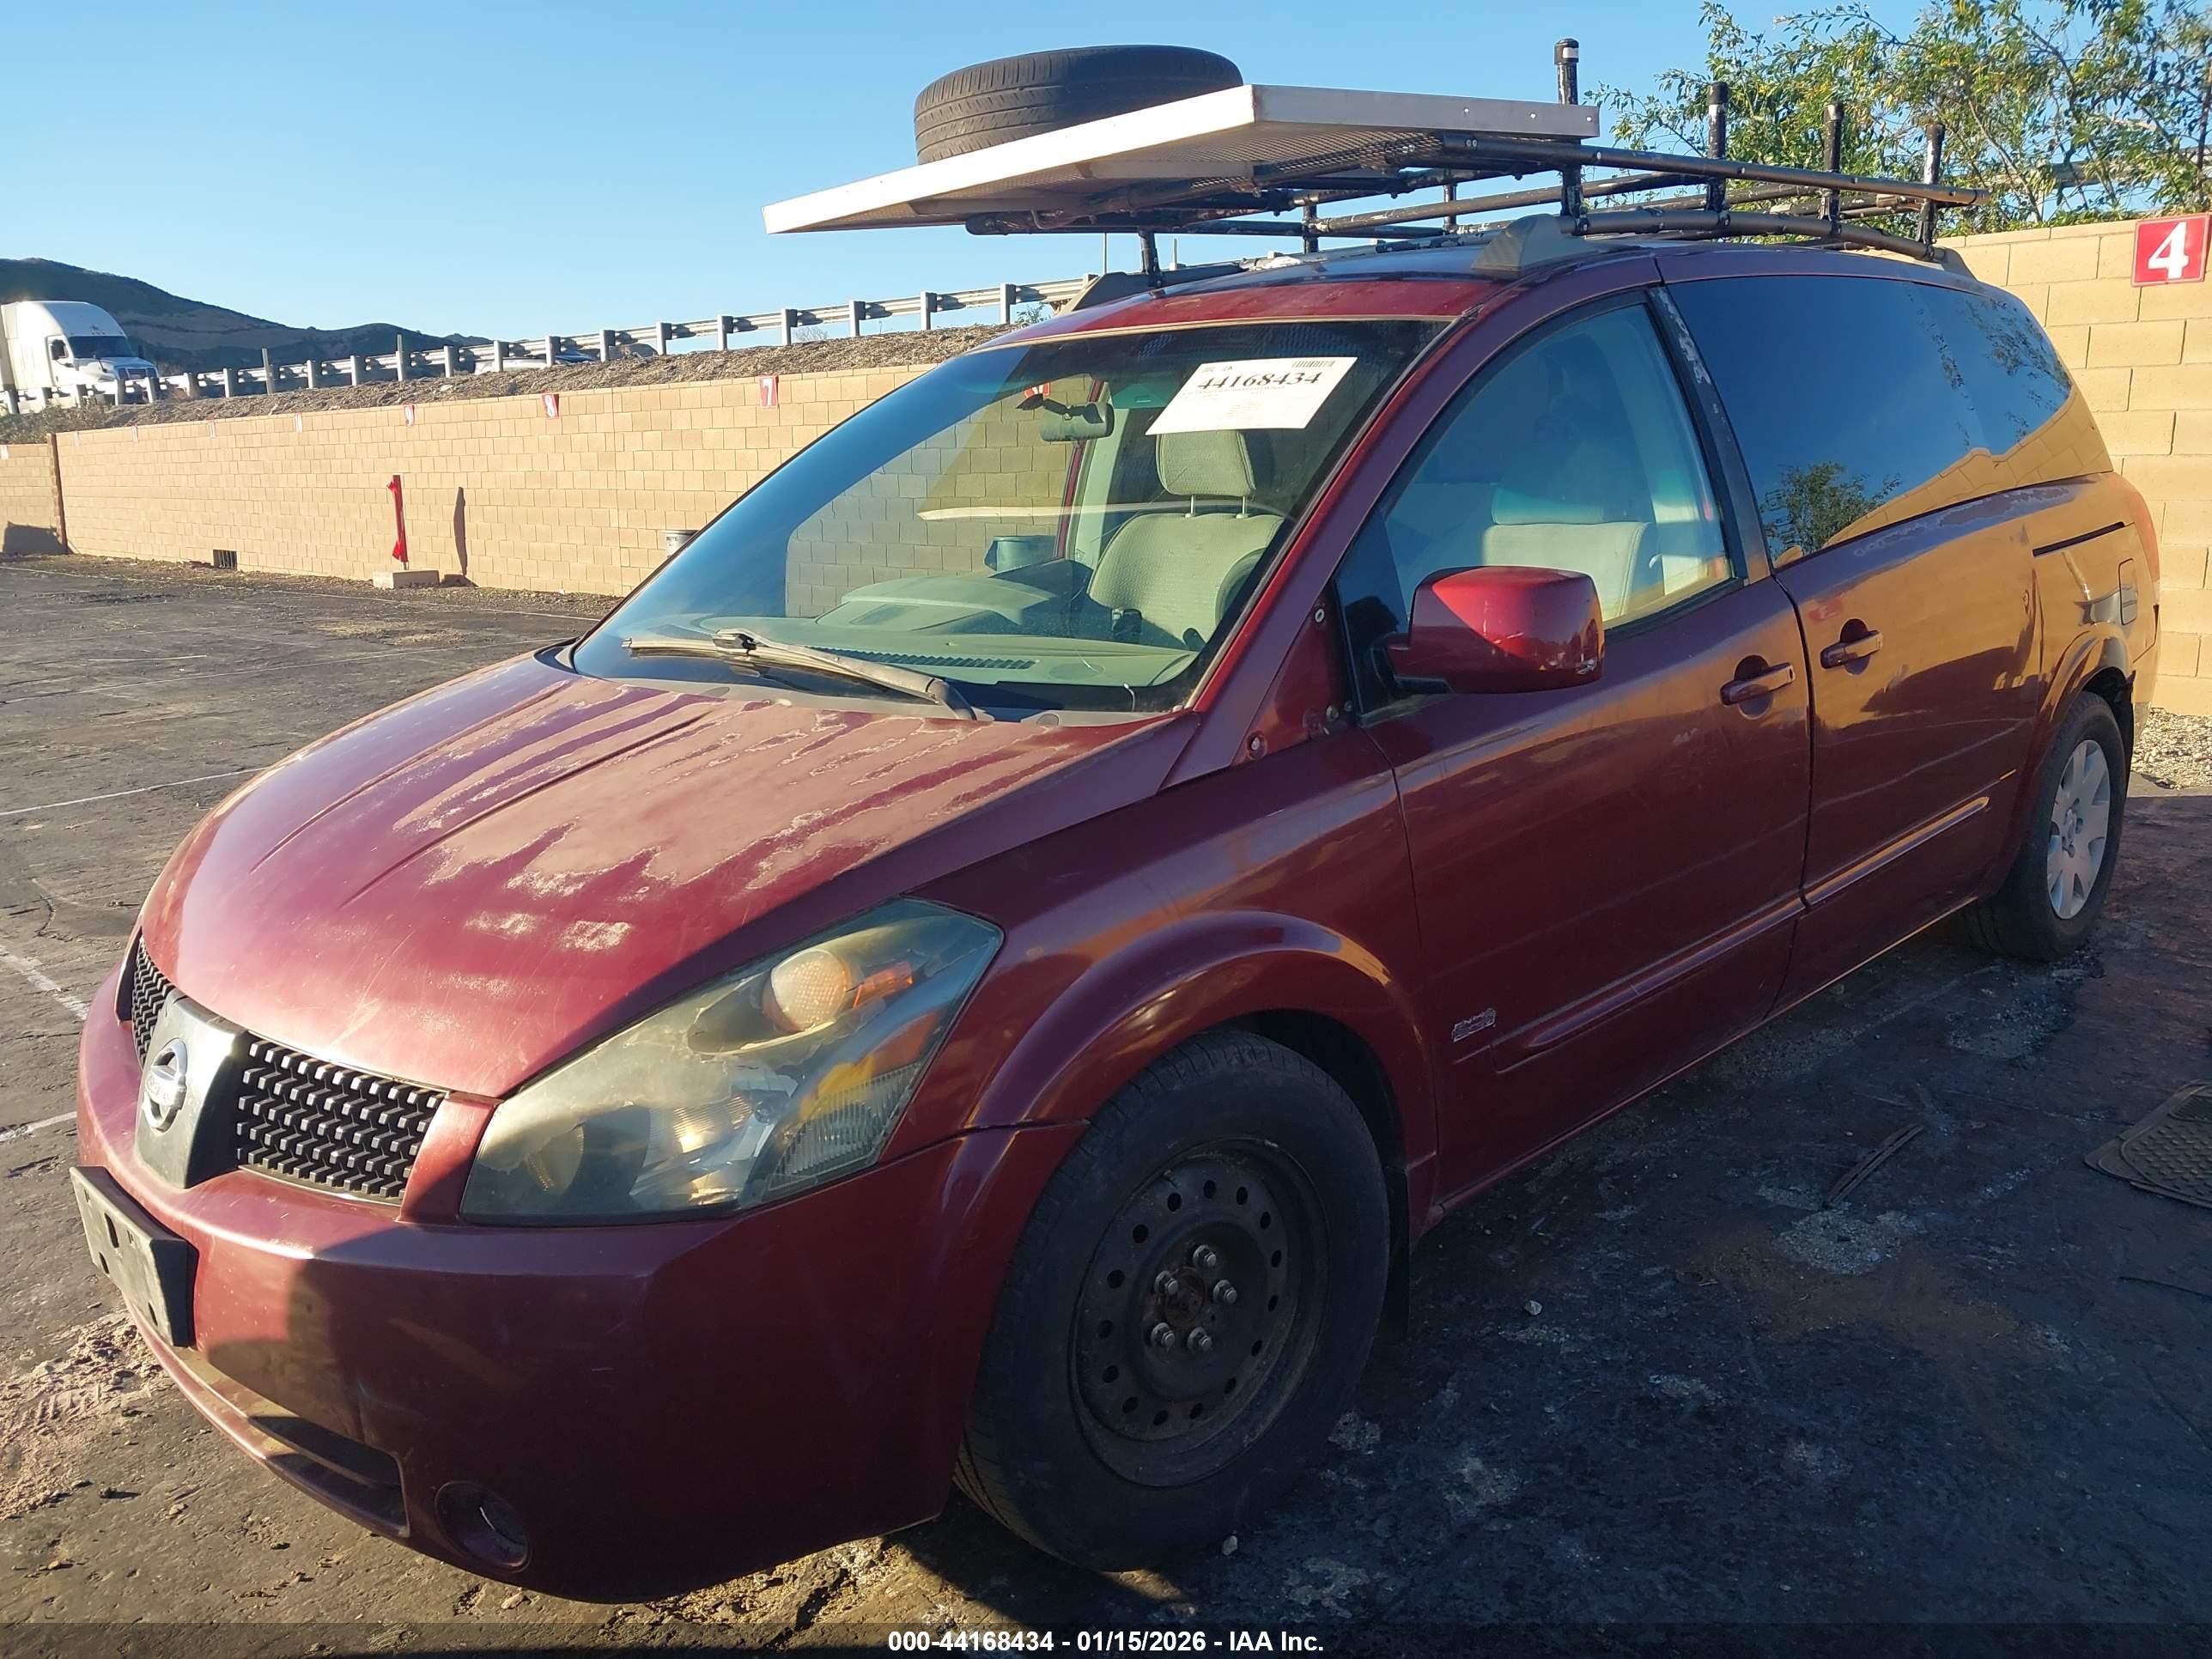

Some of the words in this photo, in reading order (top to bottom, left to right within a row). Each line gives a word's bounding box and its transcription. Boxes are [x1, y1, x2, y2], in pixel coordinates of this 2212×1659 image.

[2148, 221, 2189, 279] 4
[762, 377, 773, 406] 7
[1197, 372, 1323, 390] 44168434
[404, 406, 414, 427] 9
[544, 394, 556, 418] 8
